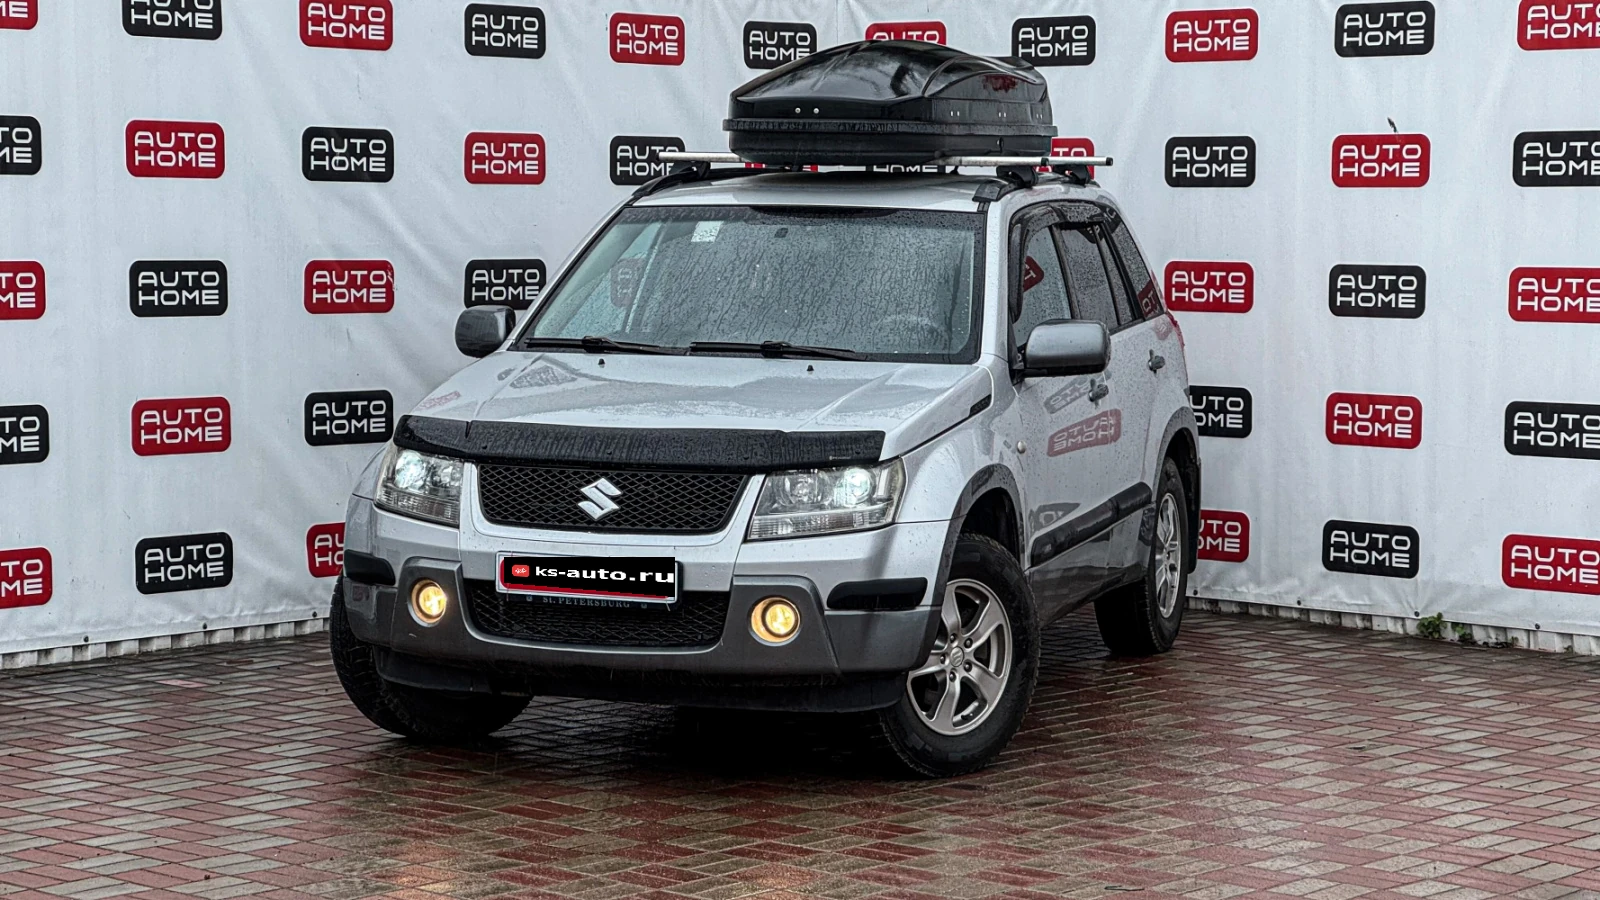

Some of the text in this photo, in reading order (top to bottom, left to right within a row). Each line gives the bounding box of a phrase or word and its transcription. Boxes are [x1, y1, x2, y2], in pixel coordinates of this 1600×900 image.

[131, 9, 213, 28] HOME
[308, 3, 385, 22] AUTO
[1344, 12, 1426, 29] AUTO
[1527, 4, 1600, 21] AUT
[308, 21, 385, 40] HOME
[472, 14, 538, 31] AUTO
[1174, 19, 1250, 35] AUTO
[617, 23, 678, 39] AUTO
[750, 31, 810, 45] AUTO
[1019, 26, 1088, 41] AUTO
[1343, 30, 1425, 46] HOME
[1527, 22, 1600, 40] HOM
[472, 31, 538, 48] HOME
[617, 39, 678, 55] HOME
[1173, 36, 1250, 52] HOME
[749, 46, 810, 60] HOME
[1019, 42, 1087, 57] HOME
[135, 132, 216, 148] AUTO
[311, 138, 386, 154] AUTO
[472, 143, 539, 157] AUTO
[1173, 146, 1248, 160] AUTO
[1340, 145, 1421, 159] AUTO
[135, 150, 216, 167] HOME
[311, 156, 386, 171] HOME
[472, 160, 539, 174] HOME
[1172, 163, 1247, 177] HOME
[1340, 162, 1420, 177] HOME
[0, 273, 36, 288] TO
[139, 272, 219, 286] AUTO
[313, 271, 386, 285] AUTO
[473, 269, 539, 283] AUTO
[1172, 271, 1245, 286] AUTO
[1337, 275, 1417, 290] AUTO
[472, 286, 539, 300] HOME
[1518, 278, 1600, 294] AUTO
[0, 292, 36, 308] ME
[139, 290, 219, 305] HOME
[313, 288, 386, 303] HOME
[1172, 288, 1244, 303] HOME
[1337, 292, 1416, 308] HOME
[1517, 296, 1600, 312] HOME
[313, 400, 386, 417] AUTO
[1190, 395, 1243, 411] UTO
[141, 408, 222, 426] AUTO
[1335, 403, 1413, 420] AUTO
[0, 416, 40, 433] TO
[313, 418, 385, 435] HOME
[1194, 412, 1242, 428] OME
[1514, 412, 1600, 430] AUTO
[141, 426, 222, 444] HOME
[1334, 420, 1412, 438] HOME
[0, 436, 39, 453] ME
[1513, 430, 1600, 449] HOME
[1199, 520, 1241, 535] TO
[1198, 536, 1240, 552] ME
[1331, 531, 1410, 550] AUTO
[145, 544, 224, 564] AUTO
[1330, 547, 1410, 567] HOME
[1511, 545, 1600, 565] AUTO
[1, 559, 43, 577] TO
[145, 562, 224, 583] HOME
[1511, 563, 1599, 584] HOME
[1, 578, 42, 597] ME
[558, 597, 630, 608] PETERSBURG
